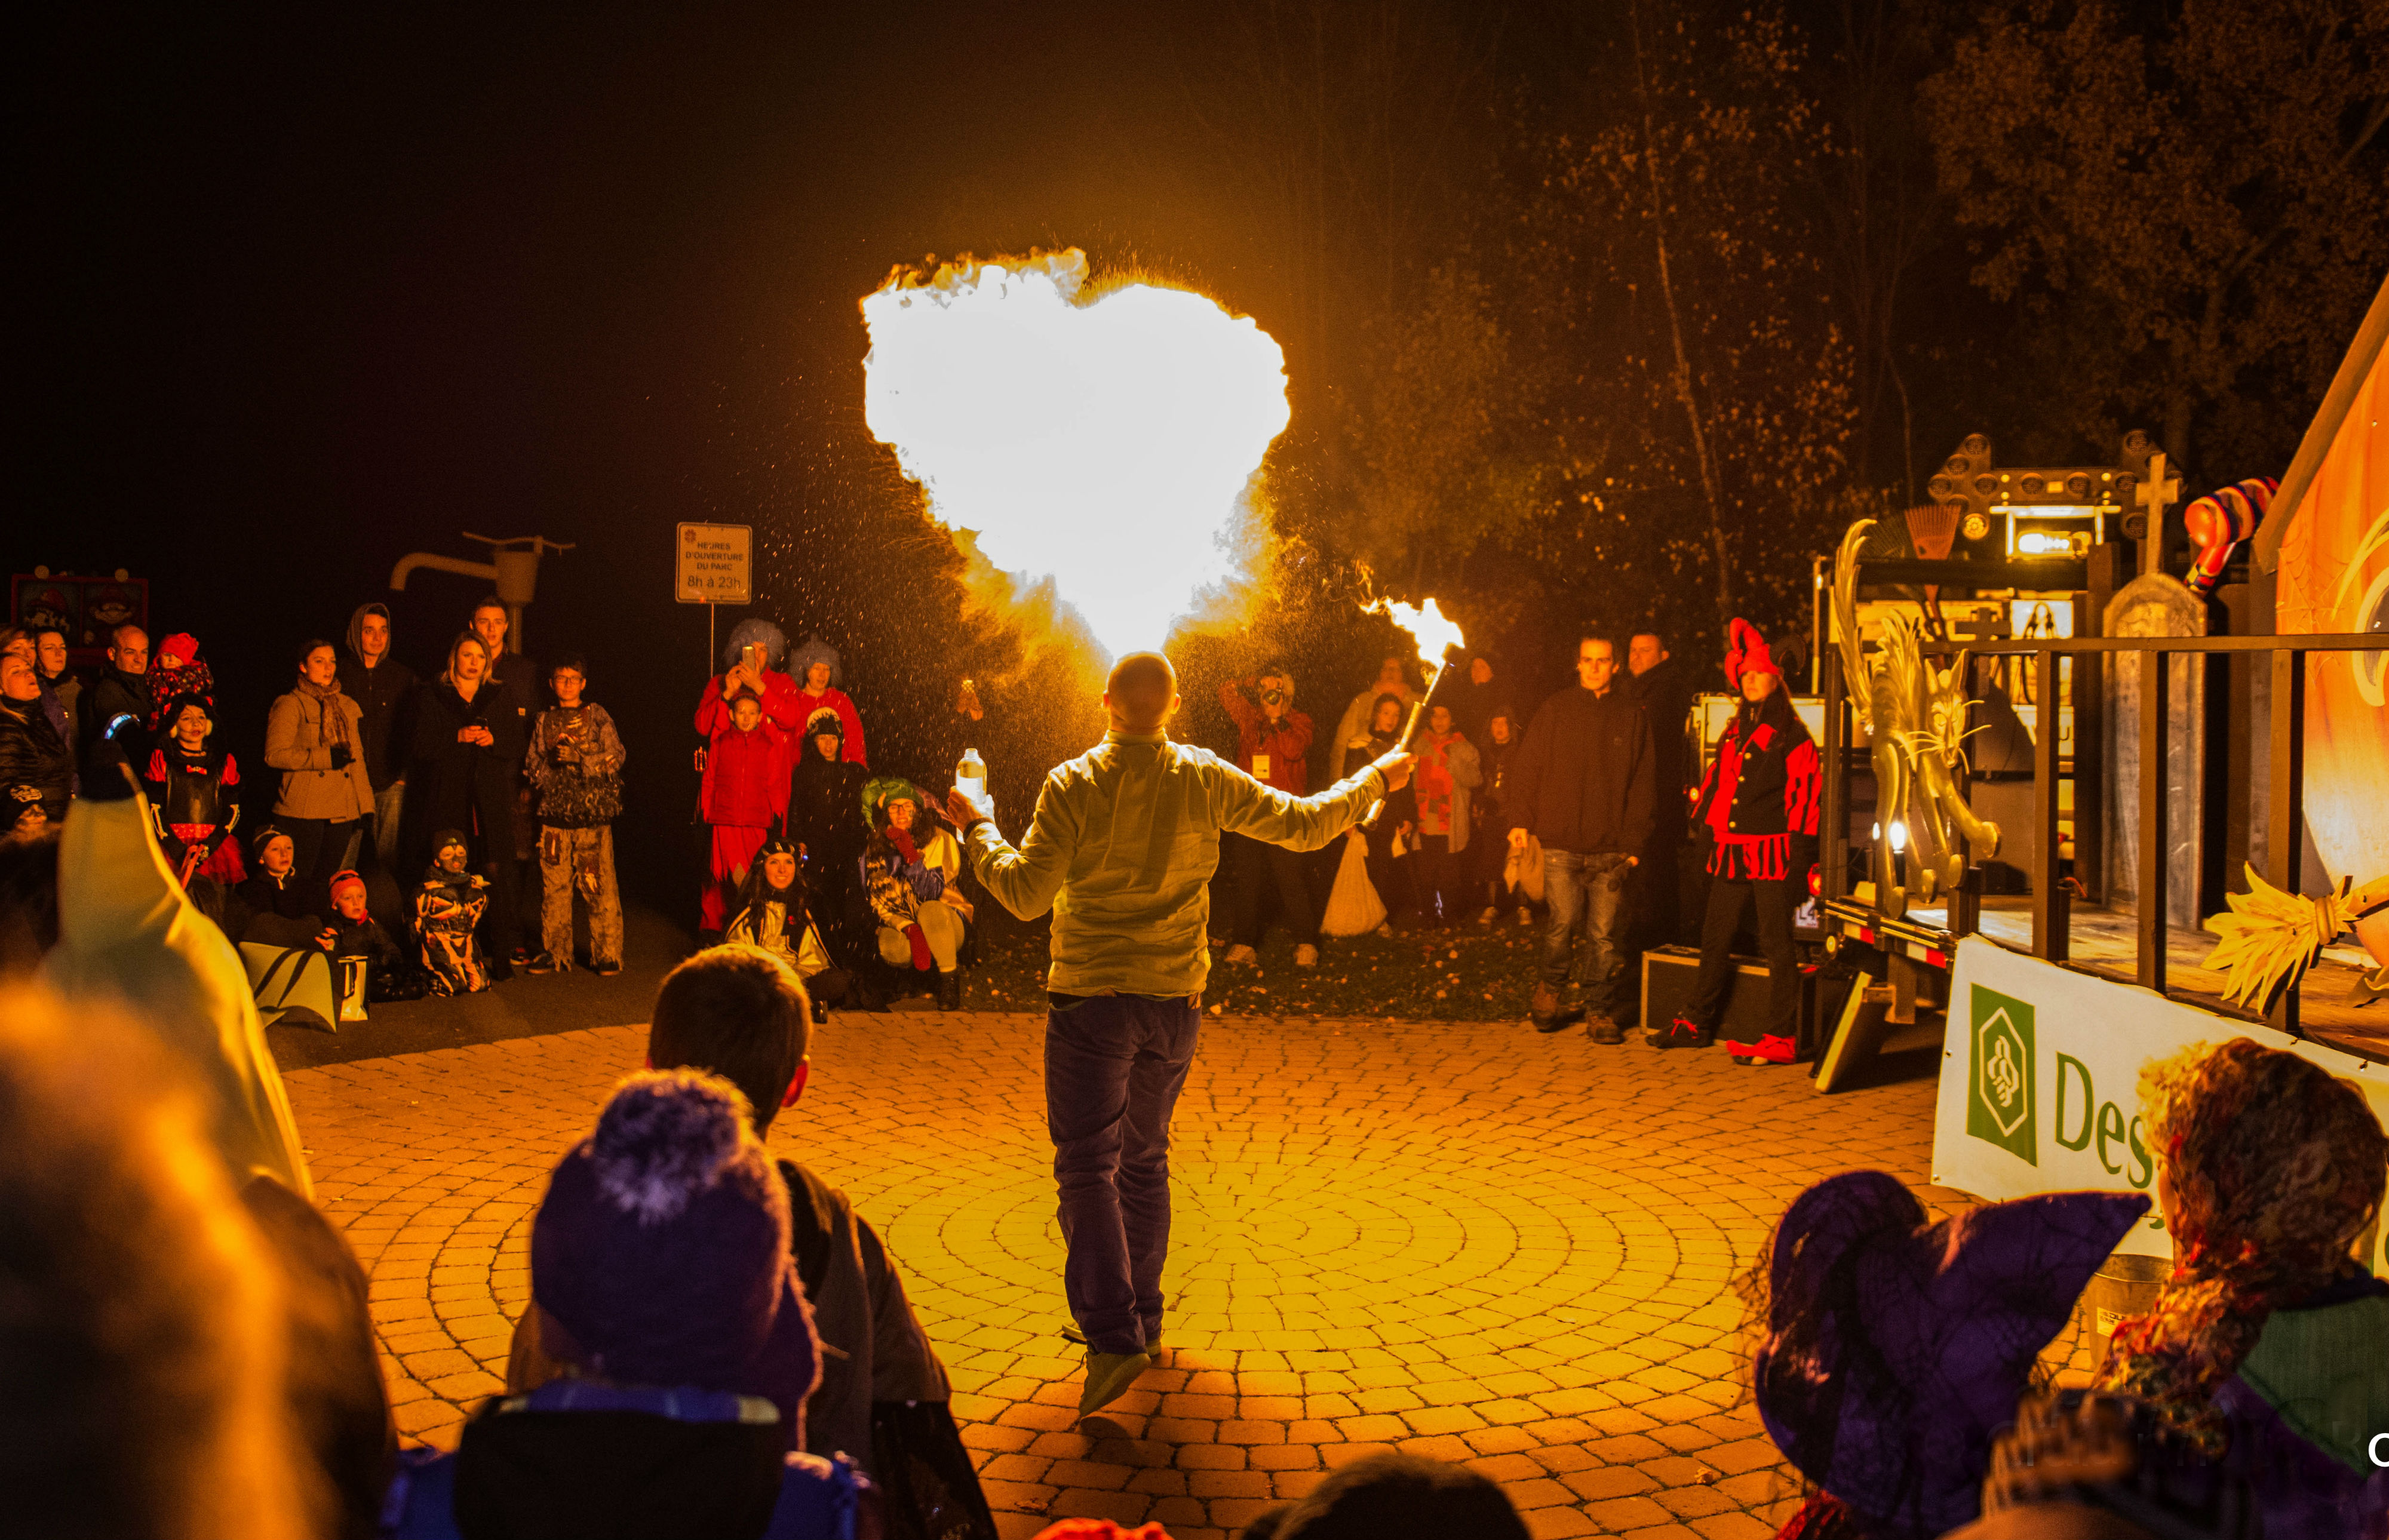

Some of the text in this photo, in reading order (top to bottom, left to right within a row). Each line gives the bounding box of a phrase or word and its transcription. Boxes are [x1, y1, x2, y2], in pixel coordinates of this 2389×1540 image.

[686, 551, 743, 561] D'OUVERTURE
[687, 575, 741, 589] 8h à 23h
[2055, 1052, 2154, 1189] Des
